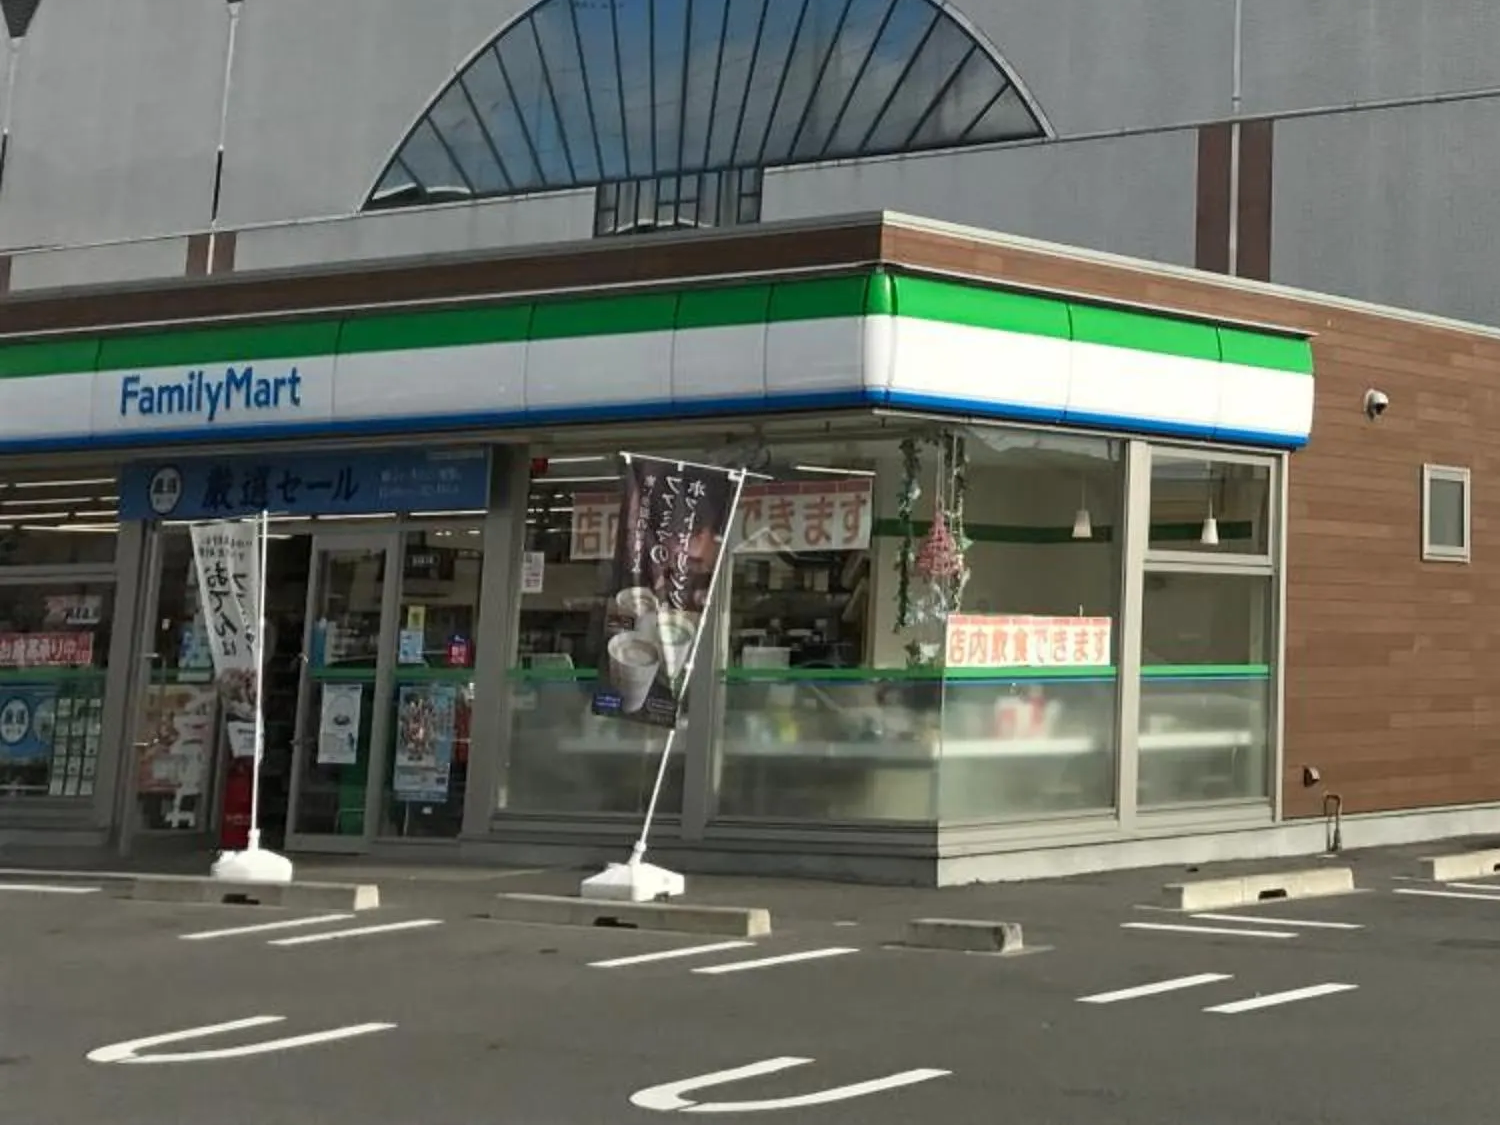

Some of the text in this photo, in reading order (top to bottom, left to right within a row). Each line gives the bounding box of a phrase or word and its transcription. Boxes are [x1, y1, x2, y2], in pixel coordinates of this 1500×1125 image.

[120, 366, 301, 421] FamilyMart
[950, 628, 1107, 664] 店内飲食できます
